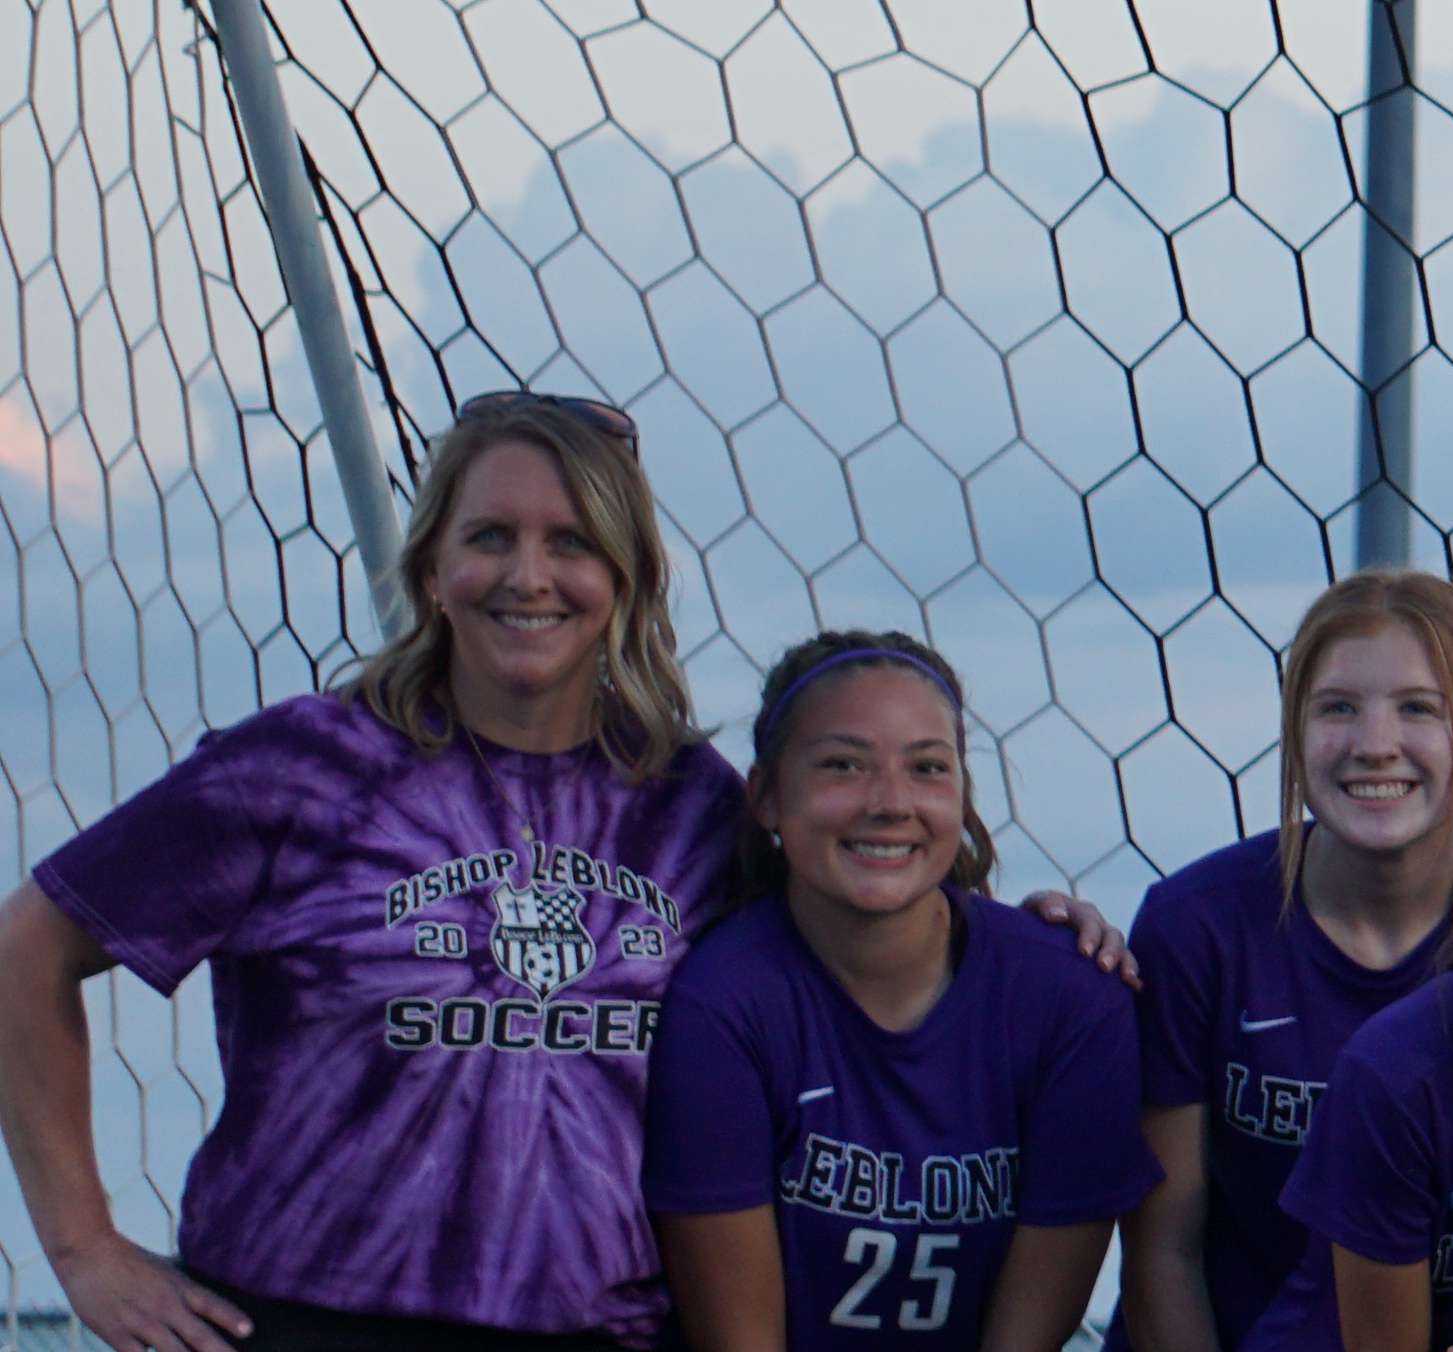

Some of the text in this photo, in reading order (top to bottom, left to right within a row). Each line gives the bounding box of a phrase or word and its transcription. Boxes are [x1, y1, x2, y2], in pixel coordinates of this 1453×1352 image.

[385, 839, 682, 936] BISHOP LEBLOND
[415, 921, 468, 959] 20
[619, 924, 667, 961] 23
[1223, 1061, 1329, 1146] LE
[780, 1131, 1019, 1225] EBLON
[829, 1227, 960, 1331] 25
